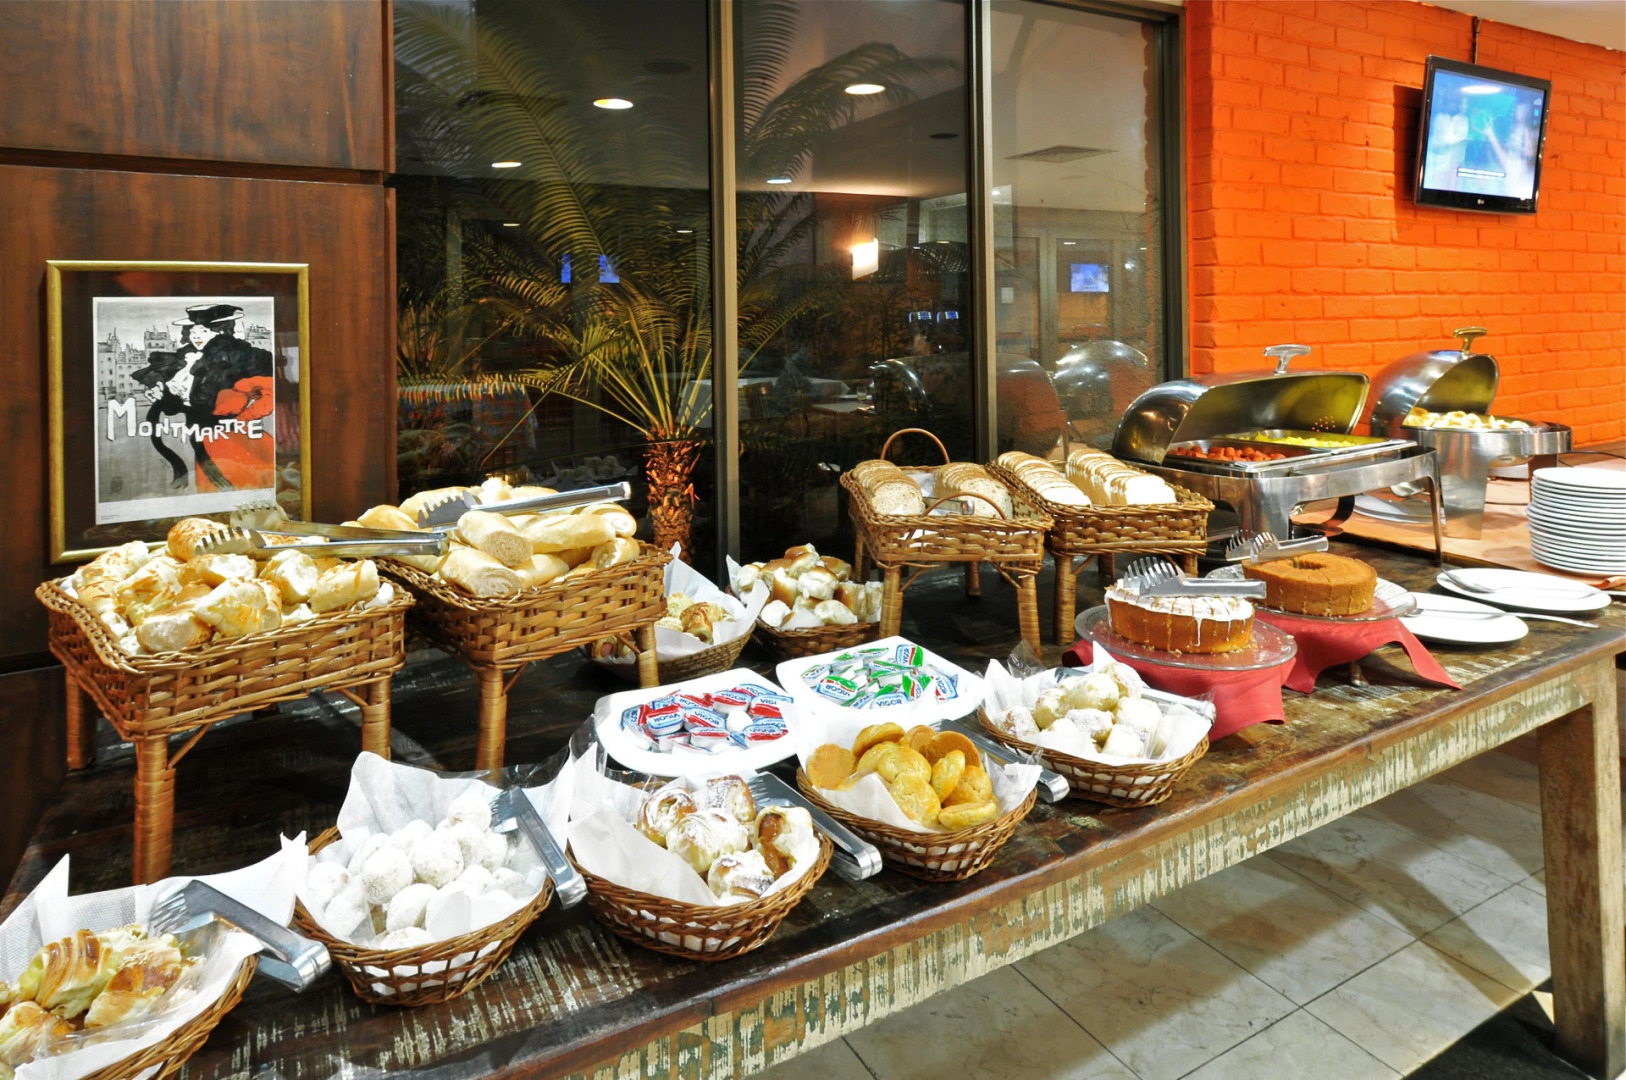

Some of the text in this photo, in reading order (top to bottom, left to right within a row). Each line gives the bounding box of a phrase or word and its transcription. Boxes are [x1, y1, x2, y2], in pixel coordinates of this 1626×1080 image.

[107, 397, 263, 443] MONTMARTRE
[721, 692, 747, 702] VIGOR
[825, 684, 851, 697] VIGOR
[876, 699, 903, 707] VIGOR
[694, 711, 720, 725] VIGOR
